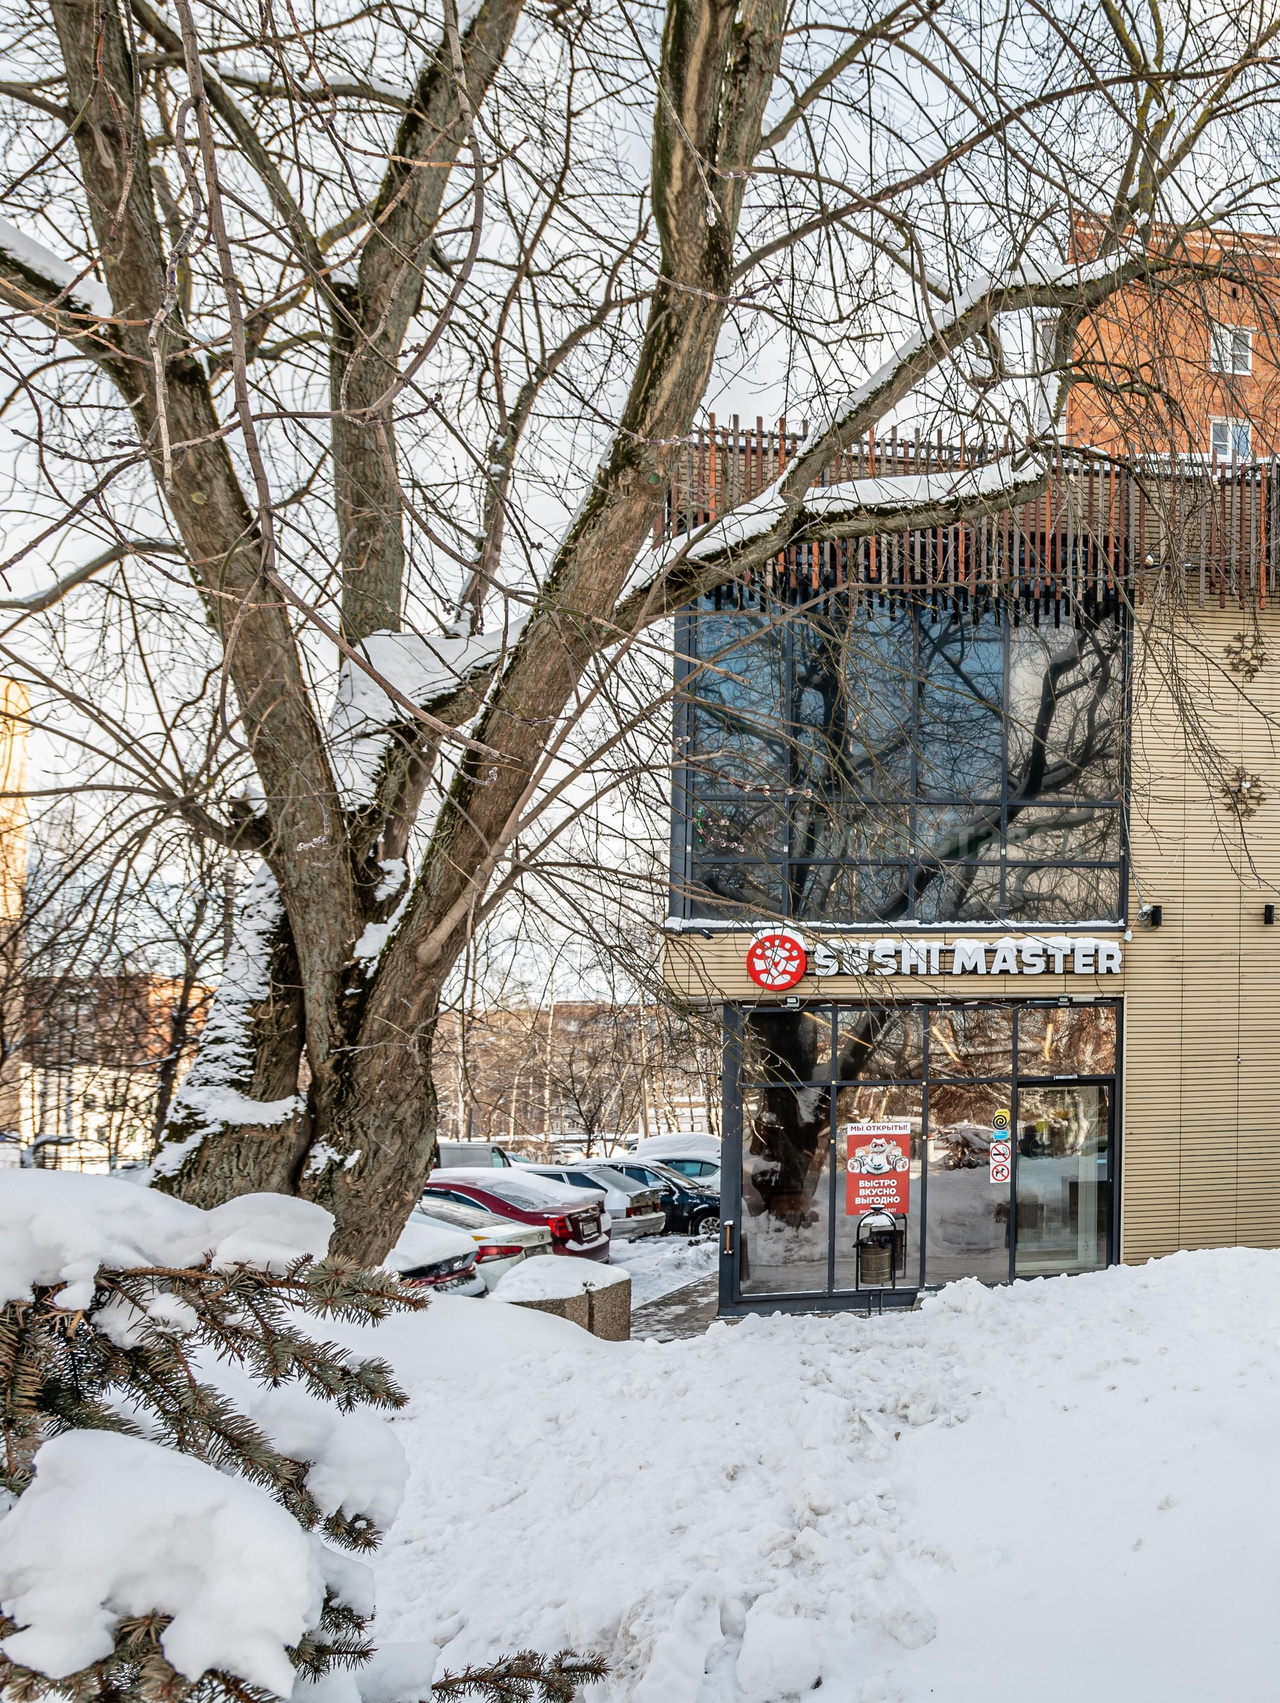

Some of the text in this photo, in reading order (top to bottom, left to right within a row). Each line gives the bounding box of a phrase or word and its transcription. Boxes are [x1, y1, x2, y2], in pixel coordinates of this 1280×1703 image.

[814, 945, 1122, 976] SUSHI MASTER
[855, 1196, 900, 1204] ВЫГОДНО
